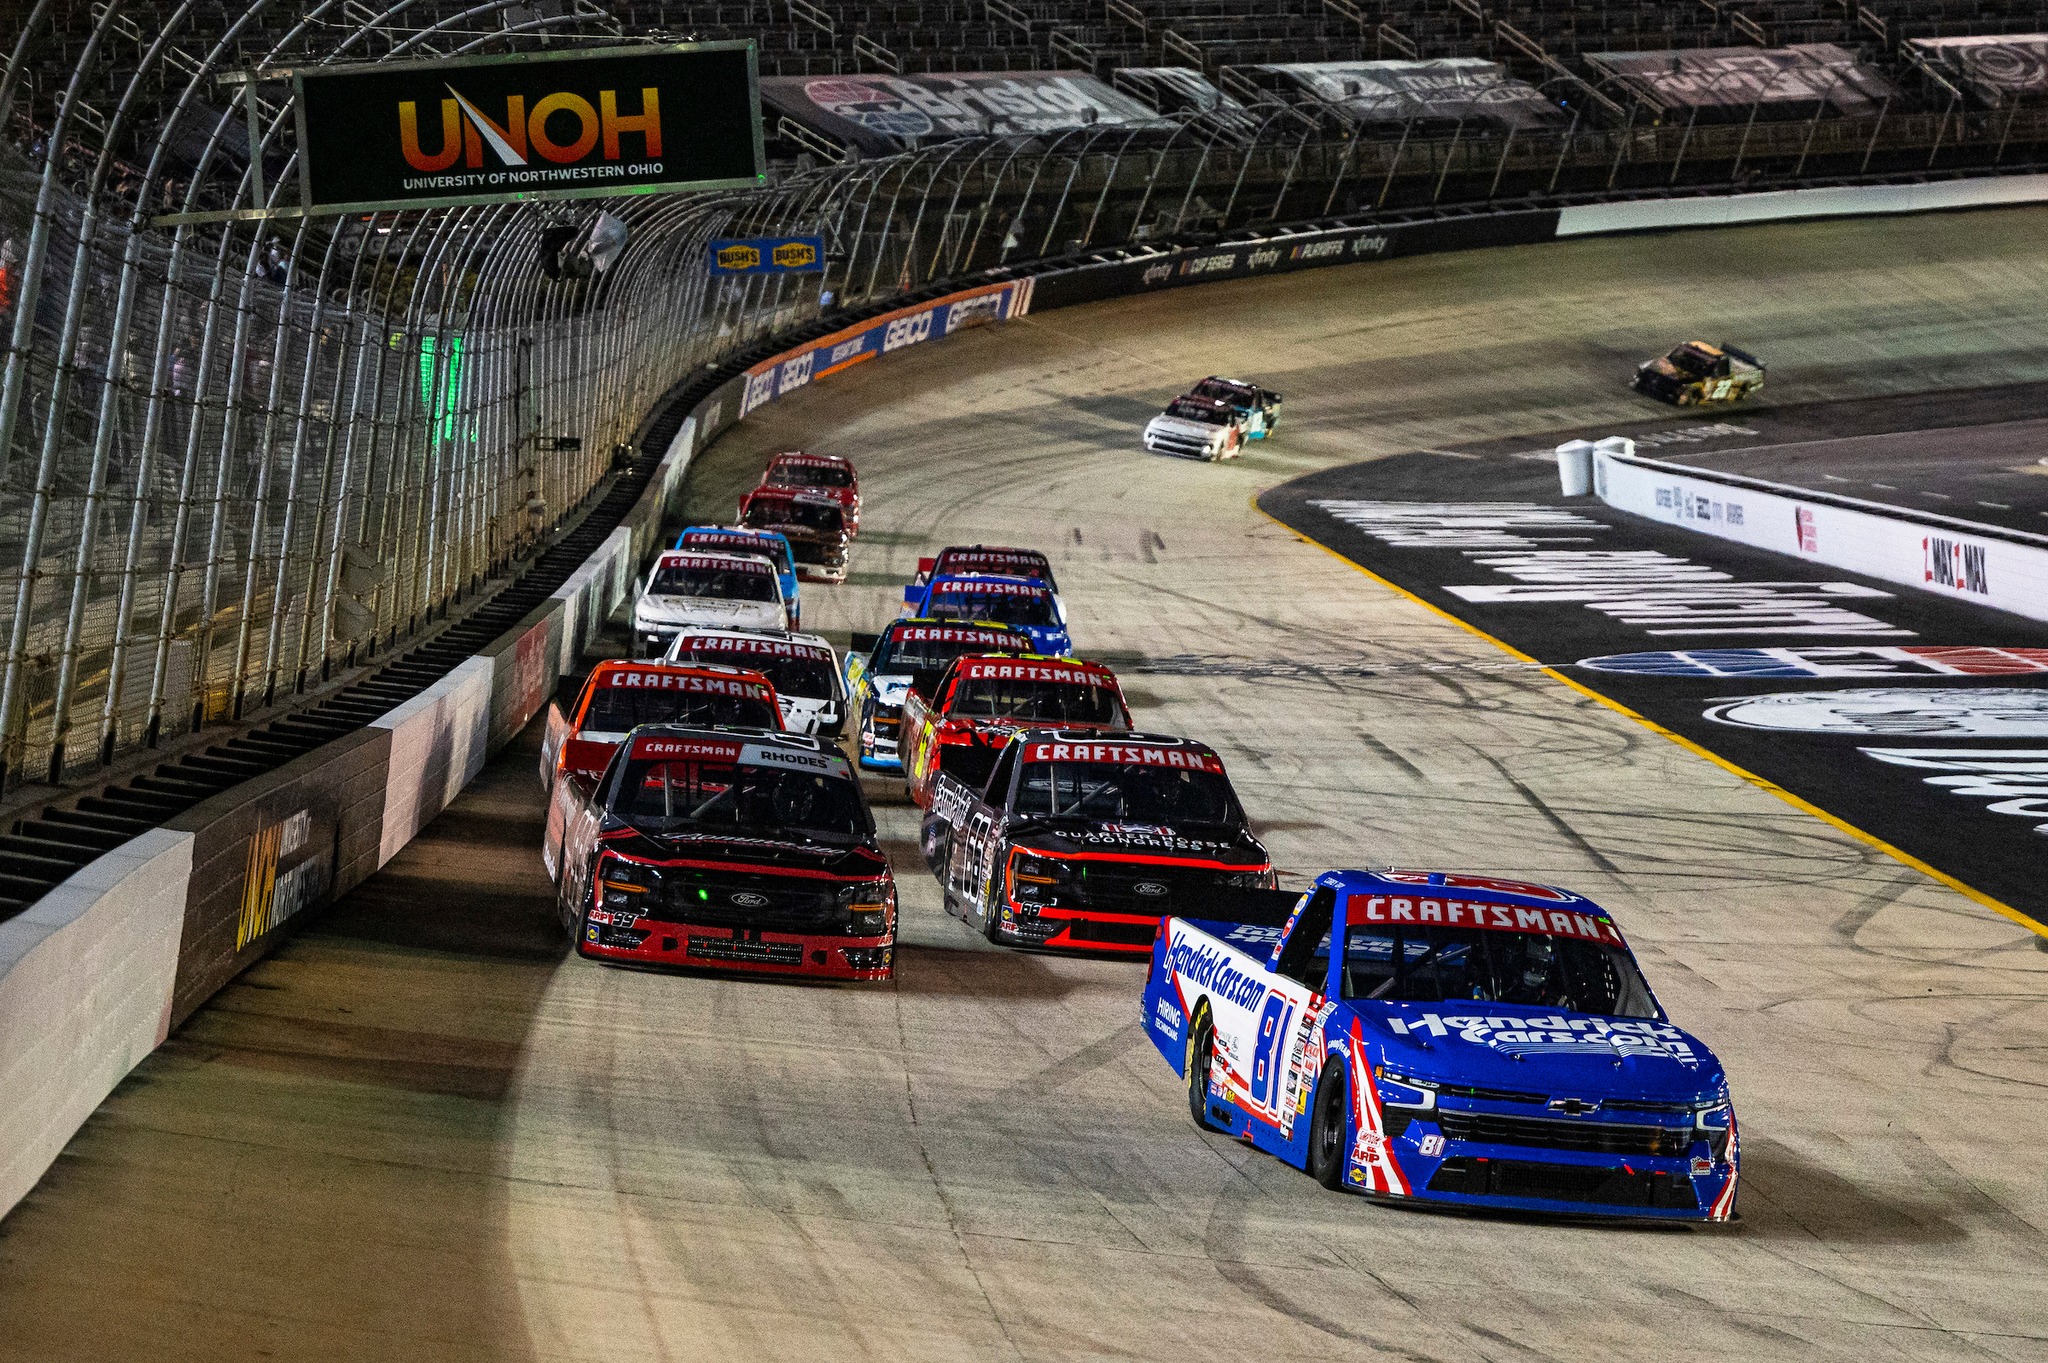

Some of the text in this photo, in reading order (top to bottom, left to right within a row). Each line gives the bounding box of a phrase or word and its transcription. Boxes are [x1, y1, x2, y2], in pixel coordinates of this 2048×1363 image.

[400, 83, 662, 172] UNOH
[404, 162, 664, 190] UNIVERSITY OF NORTHWESTERN OHIO
[774, 245, 815, 261] BUSH'S
[883, 310, 934, 352] GEICO
[691, 534, 780, 549] CRAFTSMAN
[670, 559, 770, 574] CRAFTSMAN
[949, 552, 1045, 566] CRAFTSMAN
[942, 582, 1043, 597] CRAFTSMAN
[692, 637, 821, 660] CRAFTSMAN
[903, 628, 1022, 647] CRAFTSMAN
[611, 672, 761, 700] CRAFTSMAN
[970, 664, 1103, 686] CRAFTSMAN
[645, 743, 828, 769] CRAFTSMAN RHODES
[1035, 744, 1205, 770] CRAFTSMAN
[1054, 830, 1152, 841] QUARTER
[1089, 836, 1202, 851] CONGRESS
[738, 893, 762, 905] Ford
[1139, 883, 1162, 895] Ford
[611, 910, 639, 929] 99
[1366, 897, 1603, 939] CRAFTSMAN
[1163, 930, 1267, 1013] HendrickCars.com
[1156, 996, 1182, 1028] HIRING
[1154, 1017, 1179, 1042] TECHNICIANS
[1387, 1013, 1684, 1041] Hendrick
[1250, 988, 1298, 1122] 81
[1459, 1026, 1699, 1062] Cars.com
[1352, 1148, 1380, 1163] ARP
[1419, 1134, 1446, 1157] 81
